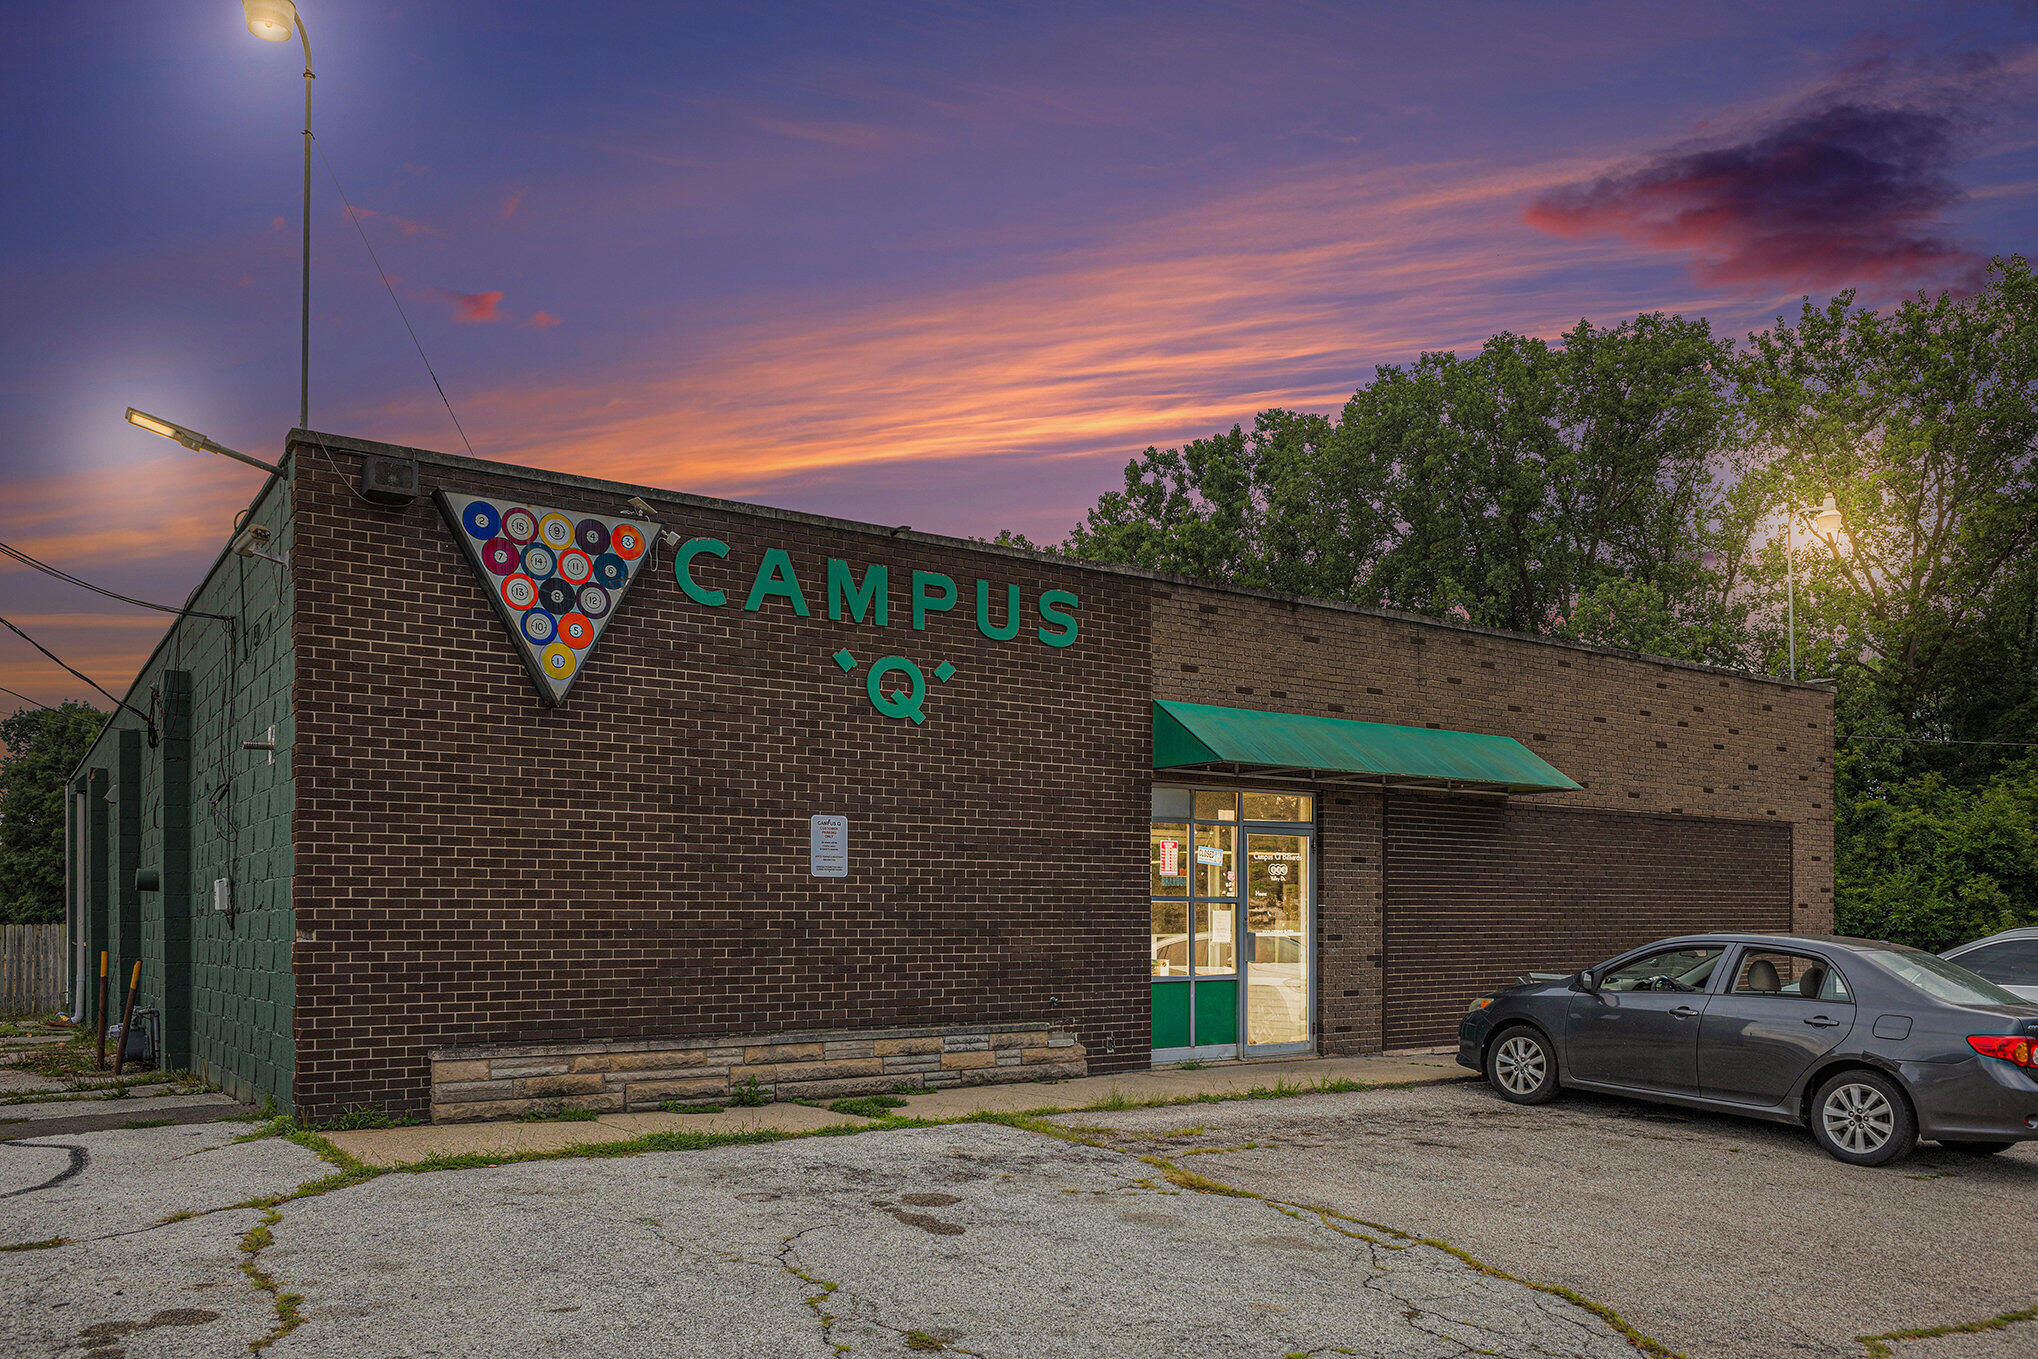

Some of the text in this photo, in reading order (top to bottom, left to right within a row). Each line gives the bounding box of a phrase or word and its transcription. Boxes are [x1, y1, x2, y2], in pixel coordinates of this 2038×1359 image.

[480, 516, 486, 525] 2
[516, 522, 525, 532] 15
[590, 532, 596, 541] 4
[625, 537, 632, 546] 3
[498, 552, 504, 561] 7
[534, 557, 544, 566] 14
[572, 562, 580, 571] 11
[515, 588, 525, 597] 13
[554, 592, 561, 601] 8
[675, 537, 1079, 648] CAMPUS
[589, 596, 598, 605] 12
[535, 622, 544, 631] 10
[573, 626, 579, 635] 5
